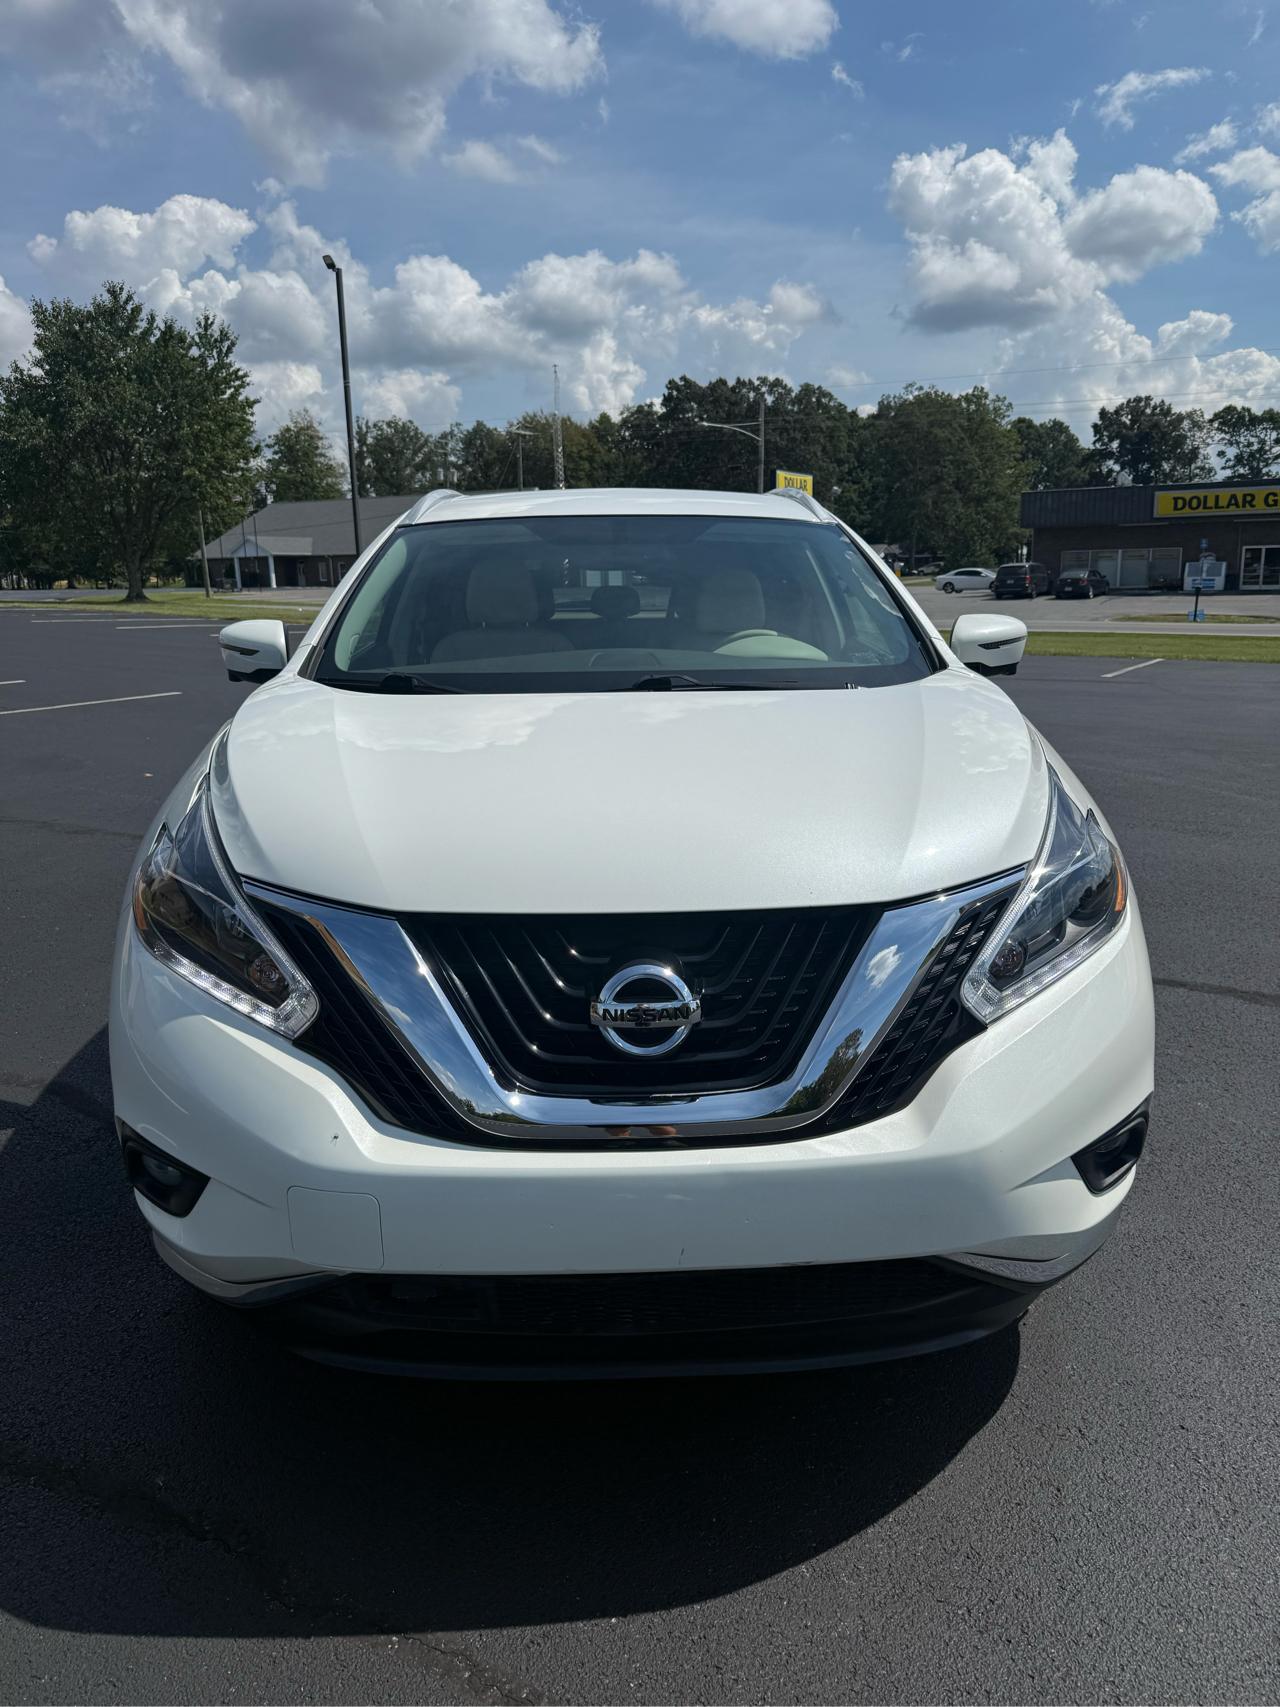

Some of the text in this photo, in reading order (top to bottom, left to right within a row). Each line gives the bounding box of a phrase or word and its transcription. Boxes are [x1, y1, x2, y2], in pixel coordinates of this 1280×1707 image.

[784, 477, 808, 491] DOLLAR
[1172, 493, 1256, 511] DOLLAR
[602, 1007, 690, 1022] NISSAN
